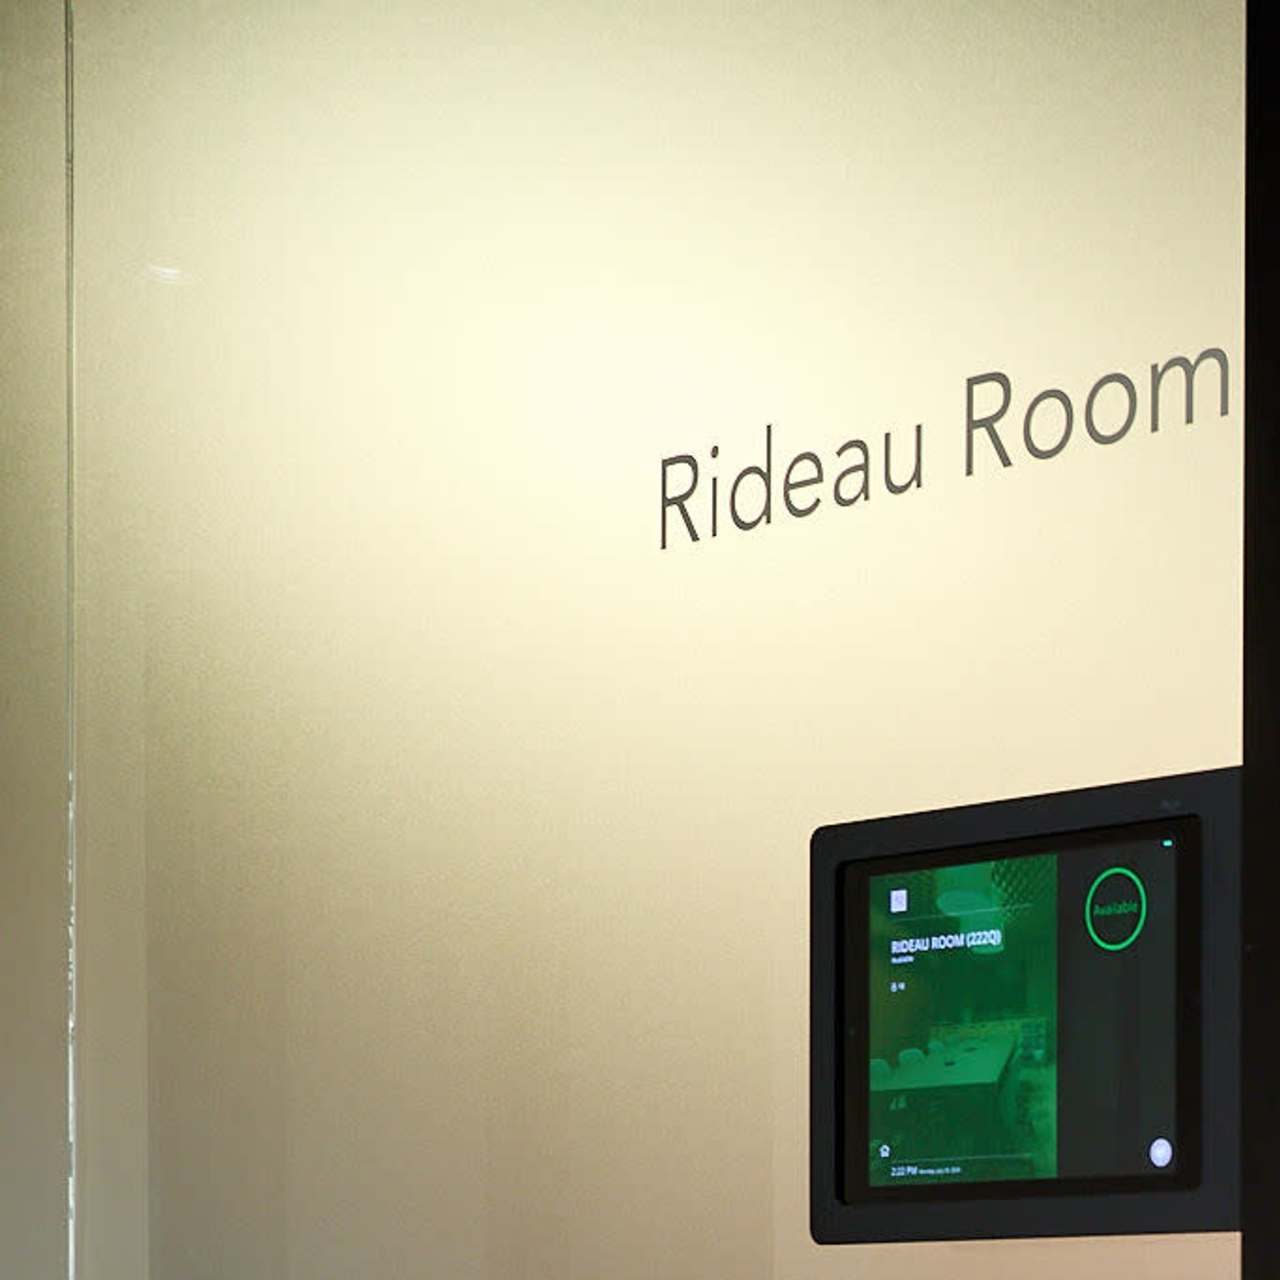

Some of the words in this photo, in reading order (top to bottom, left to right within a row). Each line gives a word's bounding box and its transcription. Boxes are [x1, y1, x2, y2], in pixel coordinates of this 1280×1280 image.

[660, 423, 923, 550] Rideau
[964, 347, 1230, 477] Room
[891, 938, 929, 954] RIDEAU
[931, 934, 964, 949] ROOM
